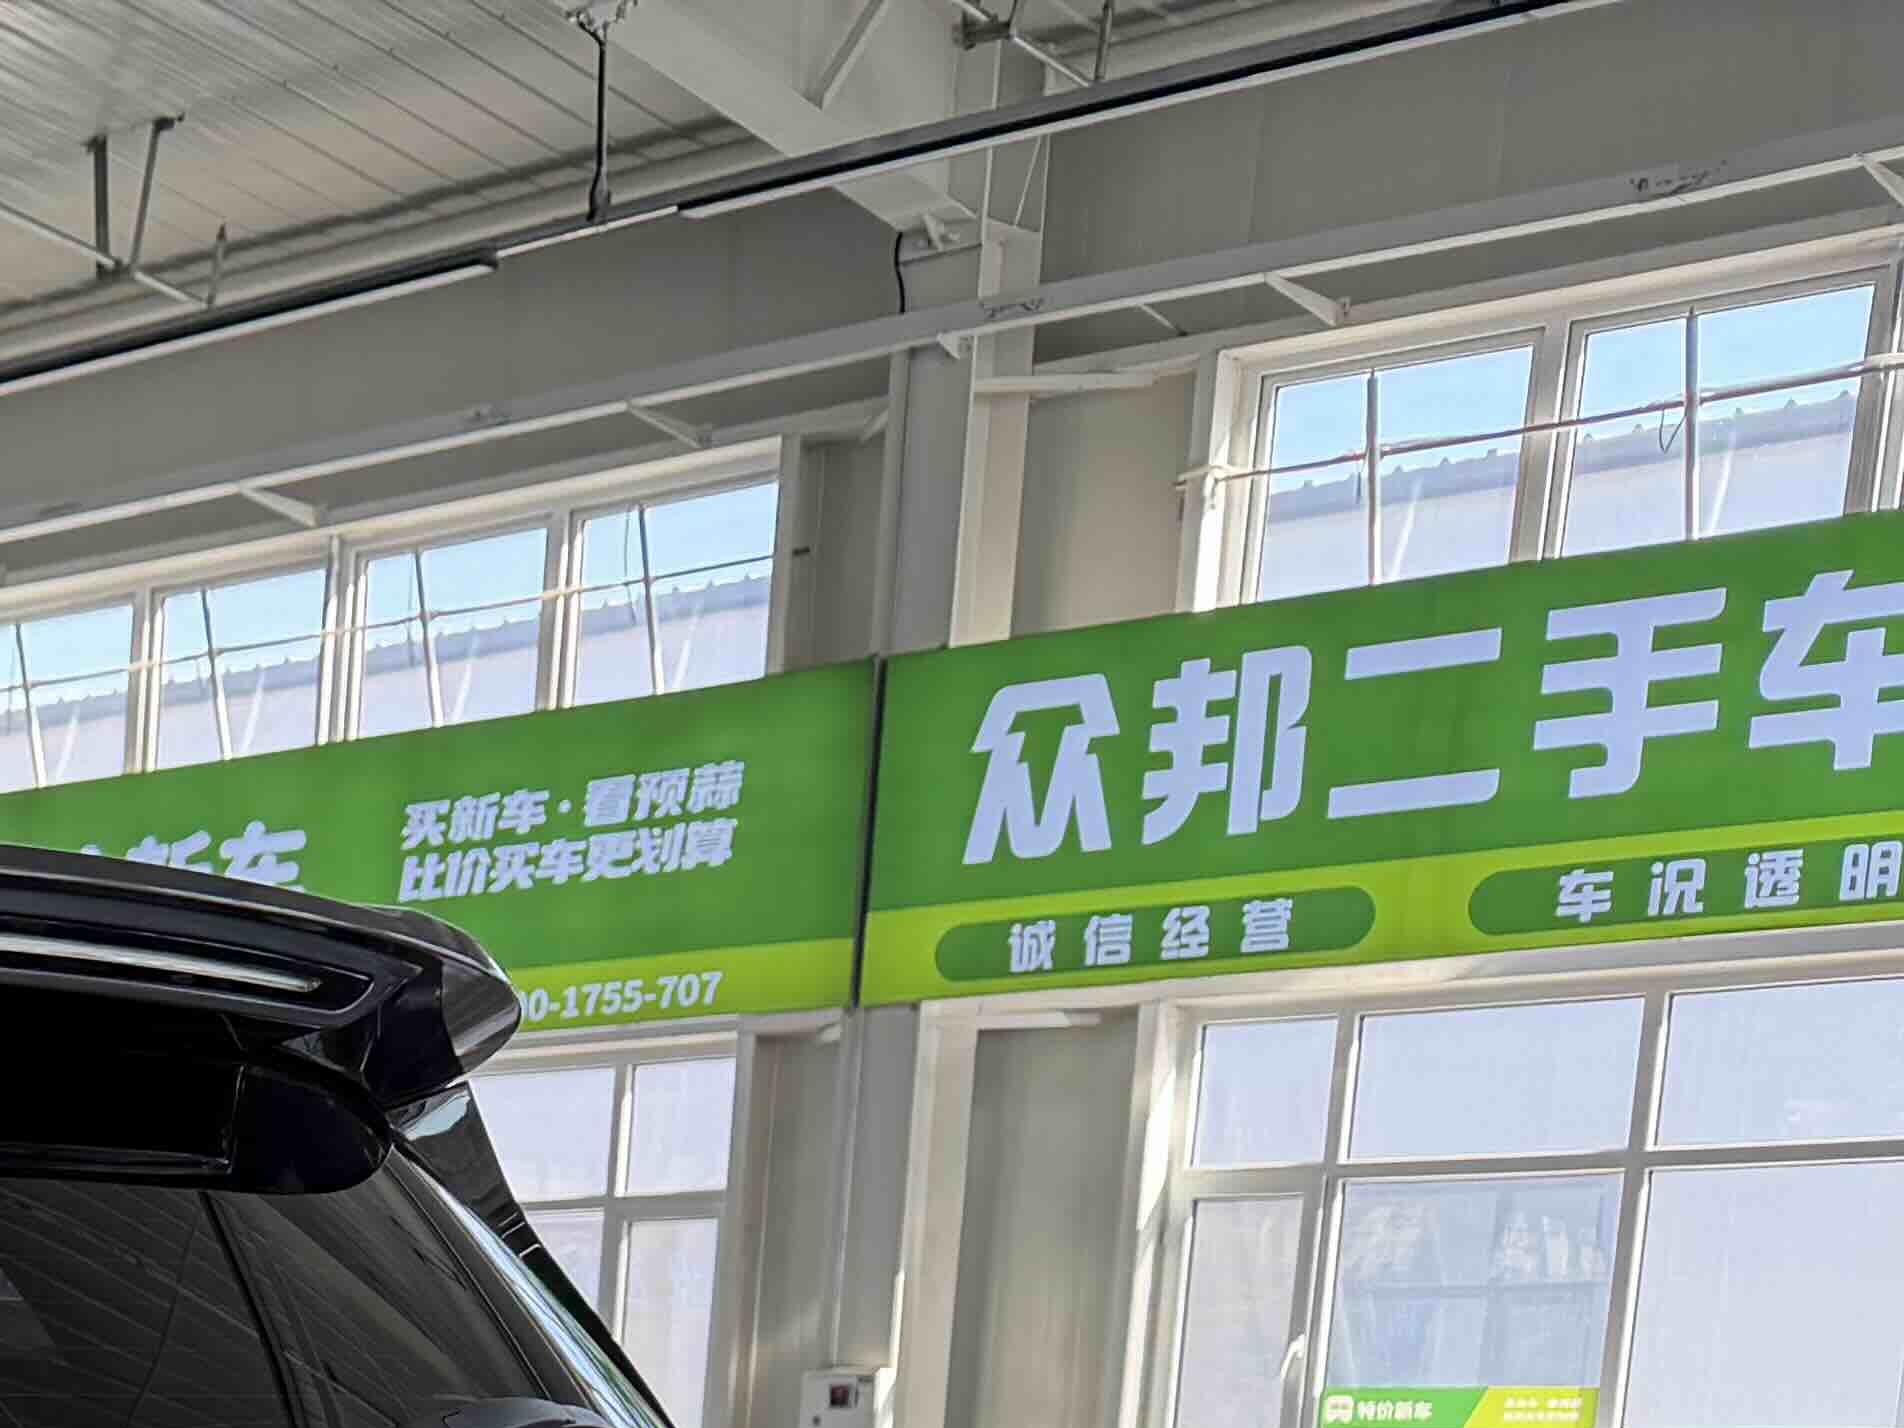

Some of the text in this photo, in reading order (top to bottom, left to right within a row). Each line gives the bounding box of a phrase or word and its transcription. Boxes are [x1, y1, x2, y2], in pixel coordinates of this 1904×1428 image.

[963, 570, 1904, 866] 众邦二手车
[397, 818, 739, 903] 比价买车更划算
[1556, 840, 1904, 925] 车况透明
[1007, 899, 1294, 974] 诚信经营
